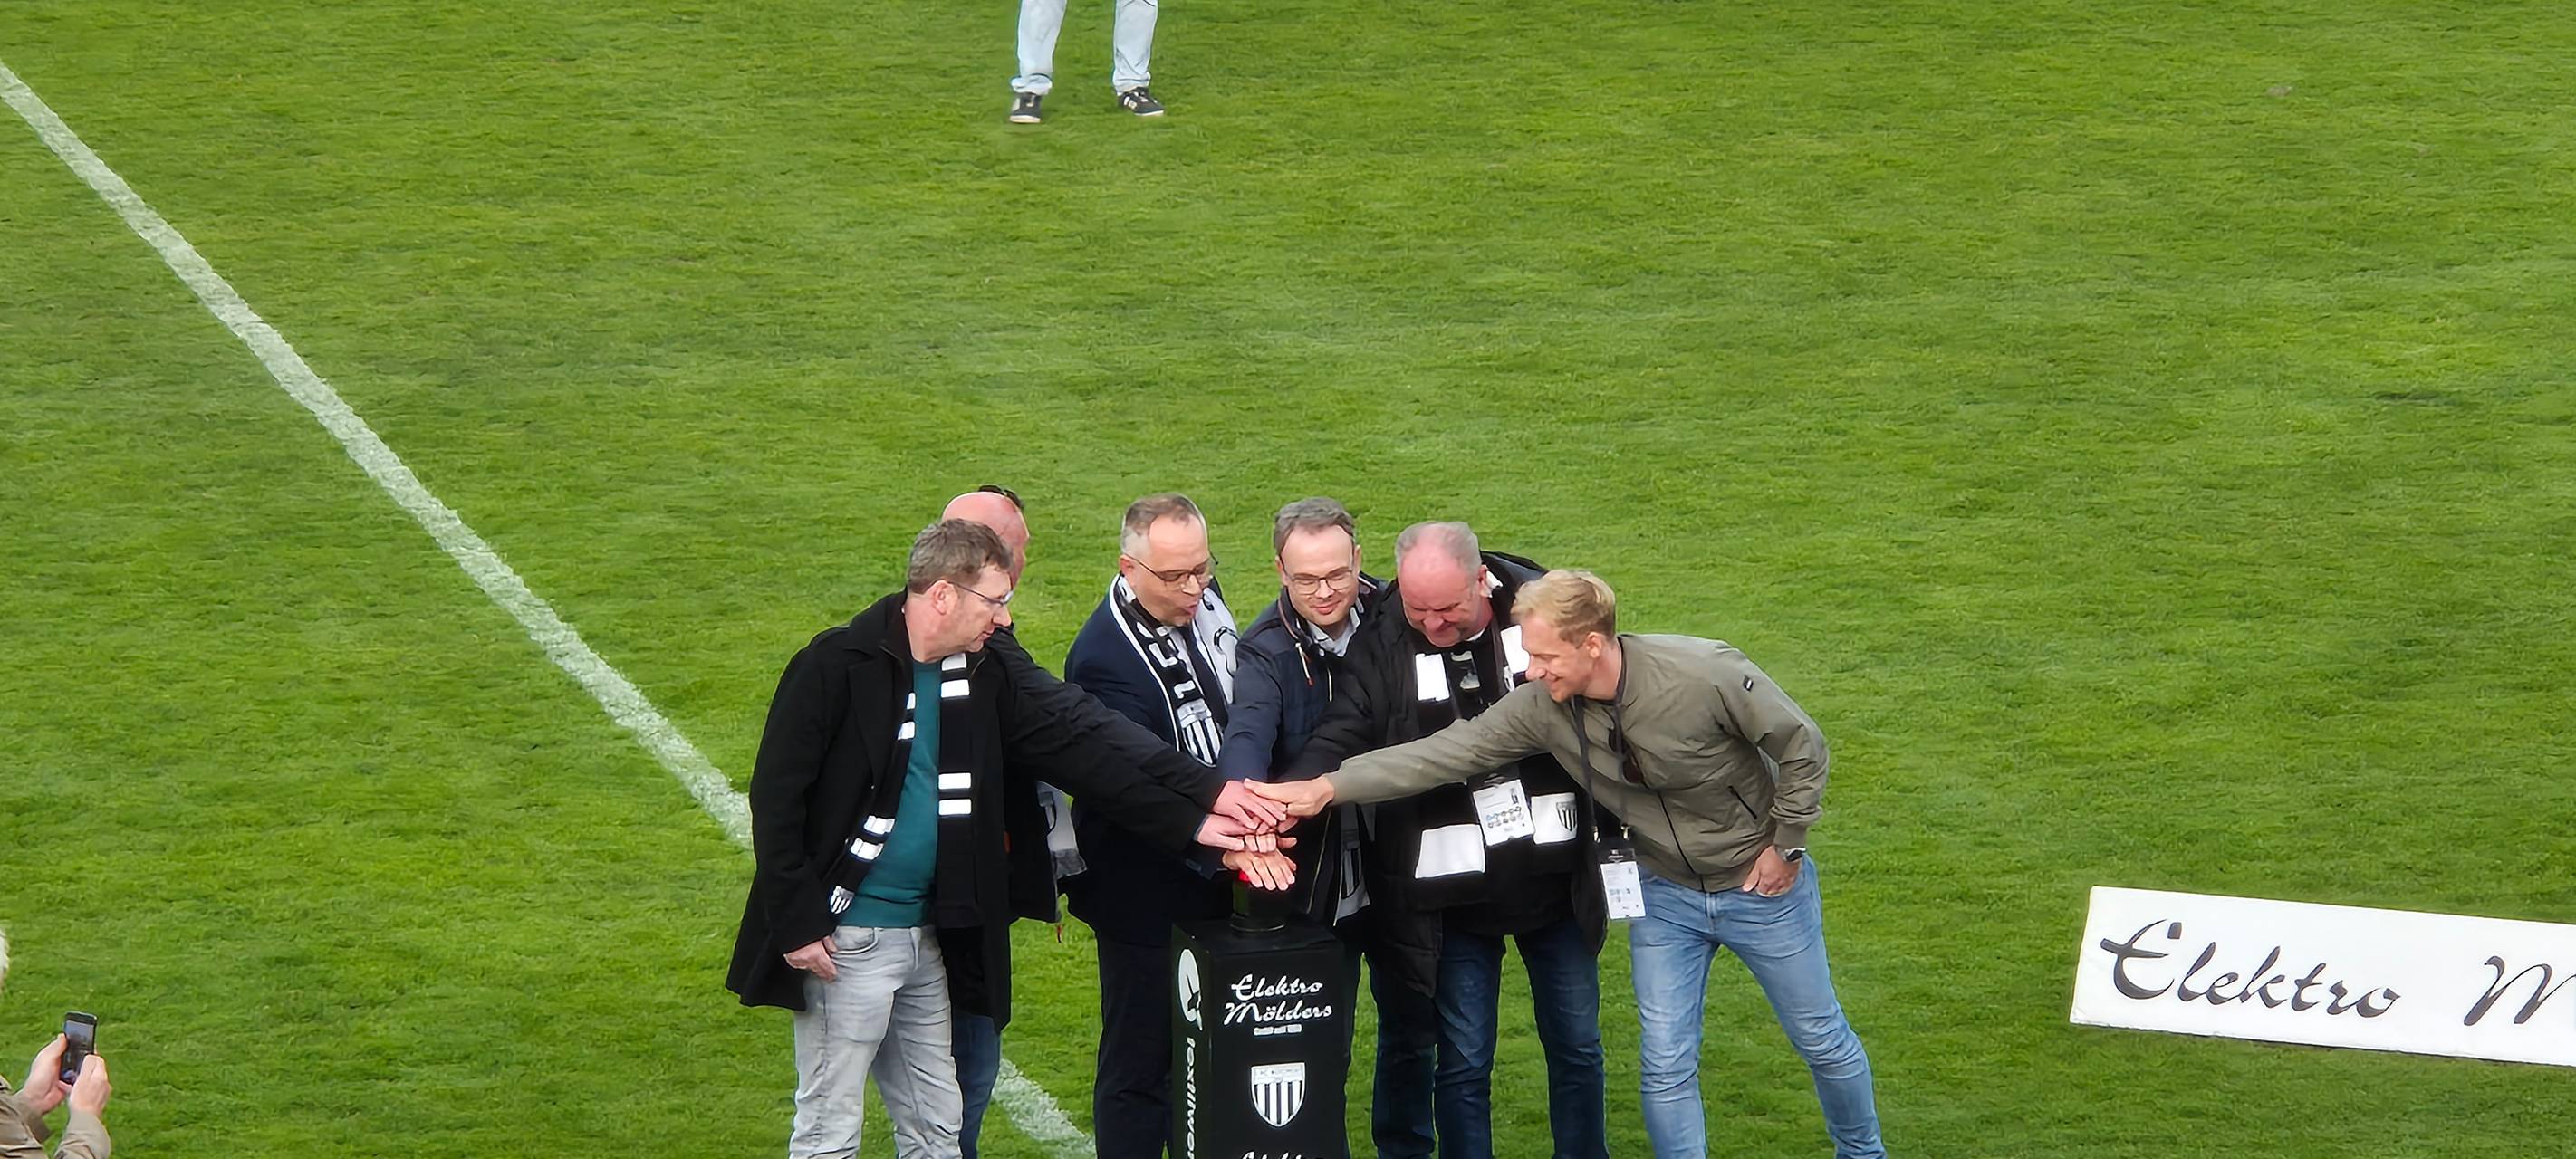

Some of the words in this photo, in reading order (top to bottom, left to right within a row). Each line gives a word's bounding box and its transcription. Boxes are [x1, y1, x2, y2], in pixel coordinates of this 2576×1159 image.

[2100, 919, 2401, 1019] Elektro
[1231, 973, 1323, 1001] Elektro
[1223, 999, 1332, 1025] Mölders
